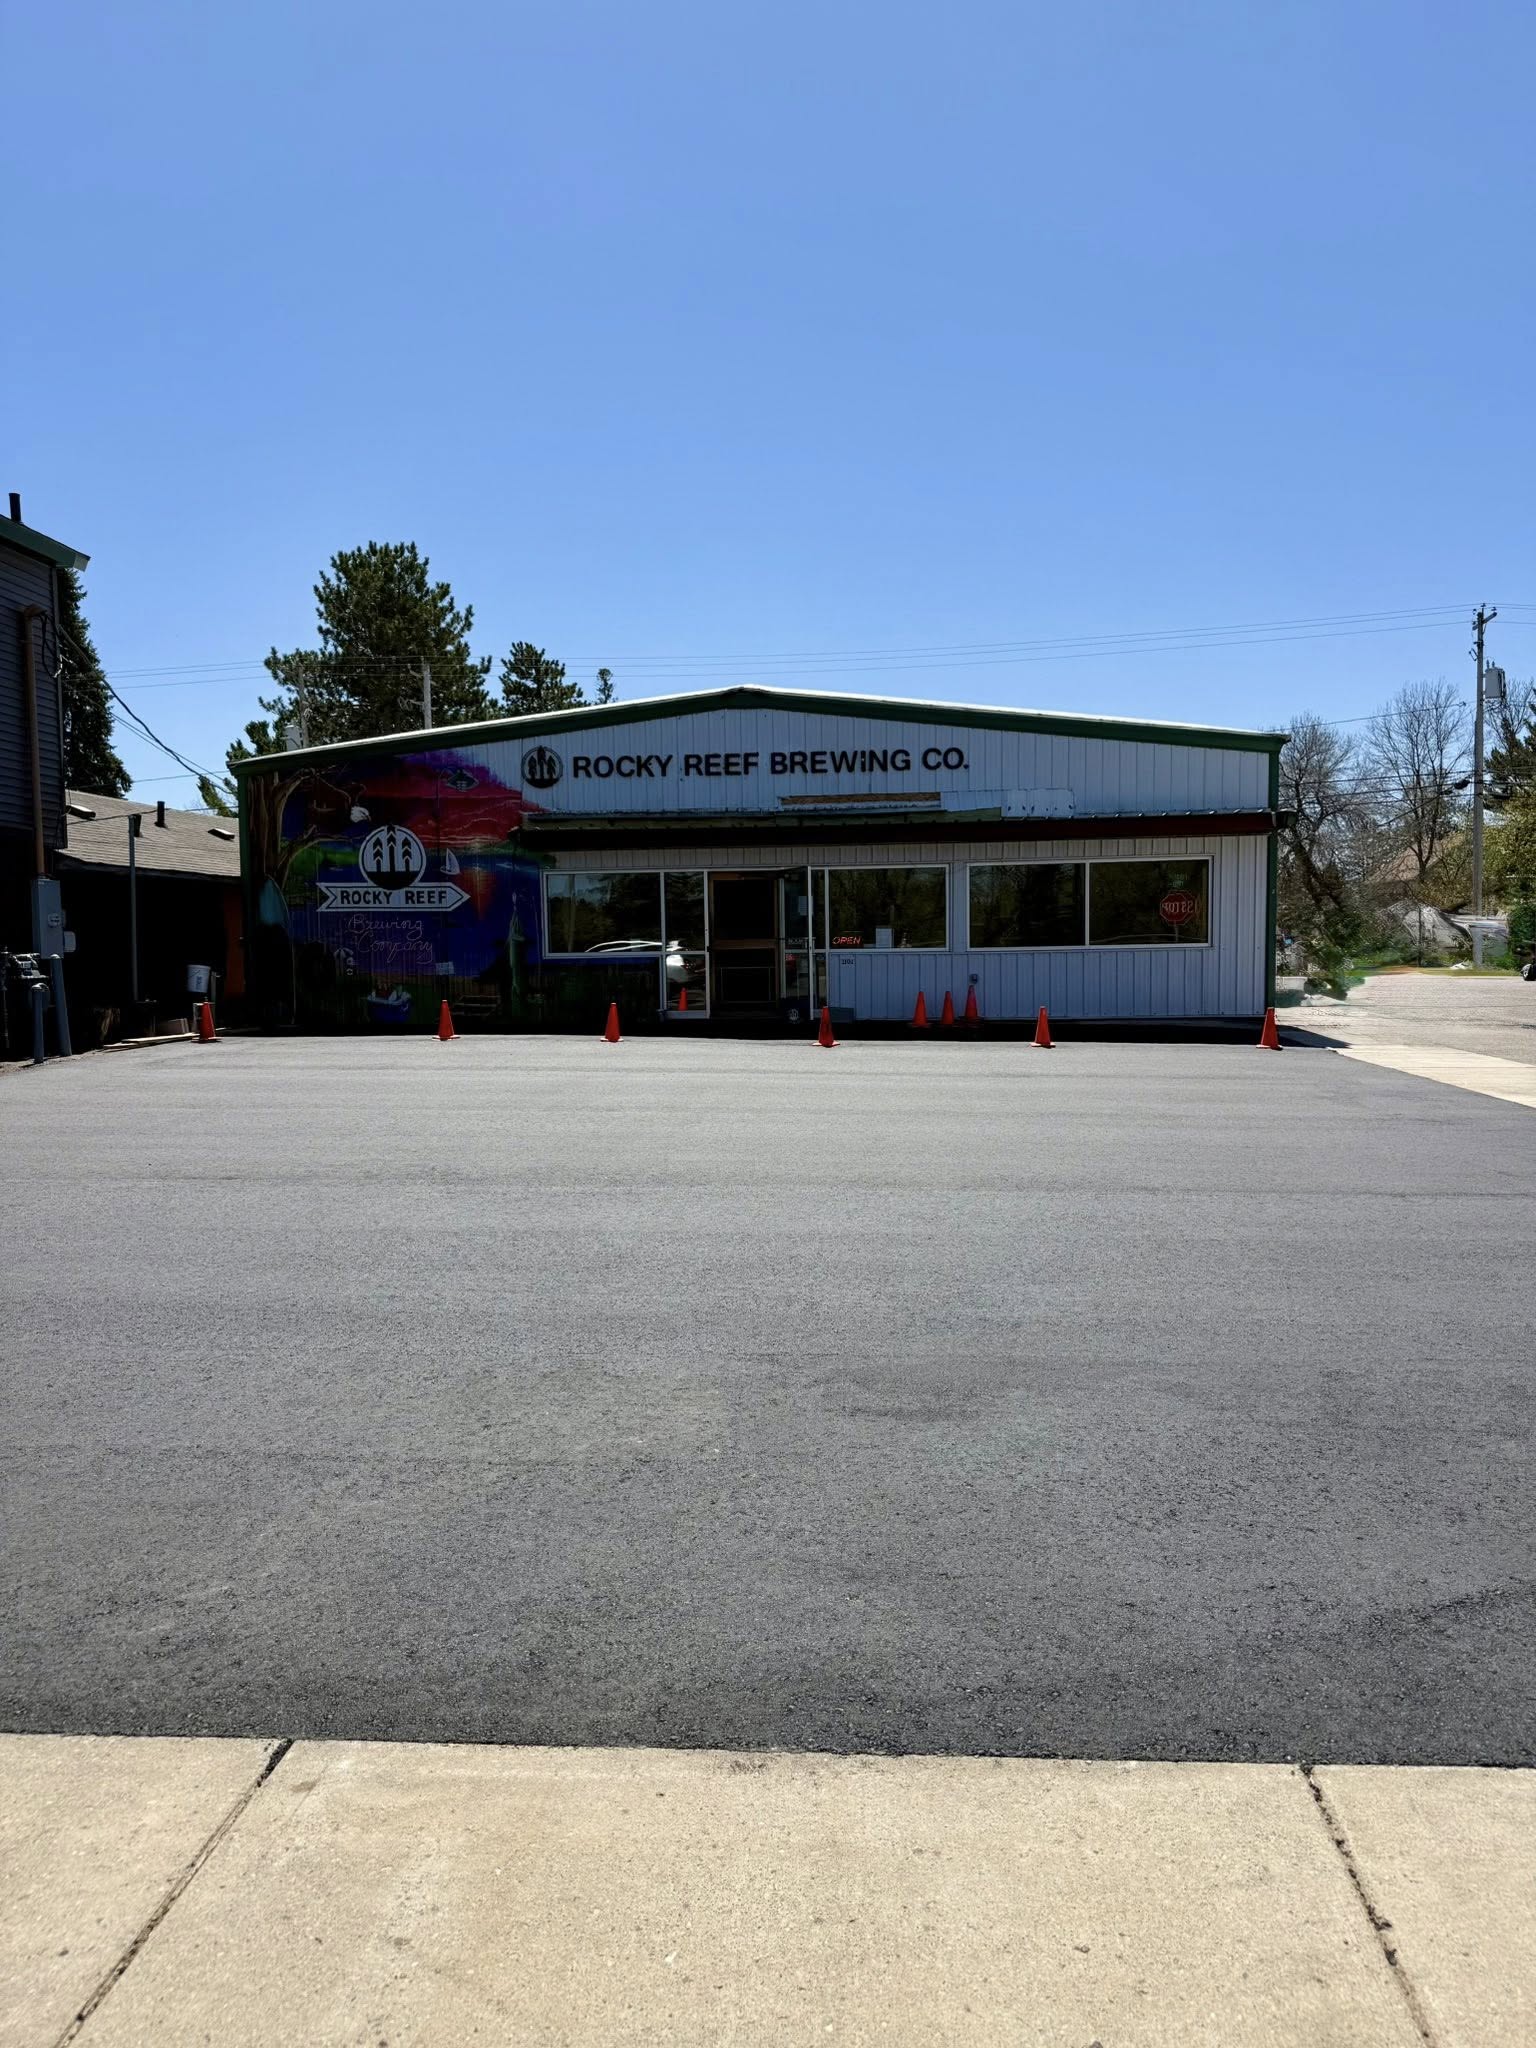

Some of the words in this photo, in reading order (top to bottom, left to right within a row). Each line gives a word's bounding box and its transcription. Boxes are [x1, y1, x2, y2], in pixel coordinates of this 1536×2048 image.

[573, 755, 673, 778] ROCKY
[684, 752, 759, 776] REEF
[770, 750, 911, 775] BREWING
[922, 747, 969, 771] CO.
[340, 890, 392, 905] ROCKY
[404, 890, 447, 905] REEF
[348, 913, 424, 940] Brewing
[356, 931, 433, 964] Company
[832, 936, 861, 945] OPEN
